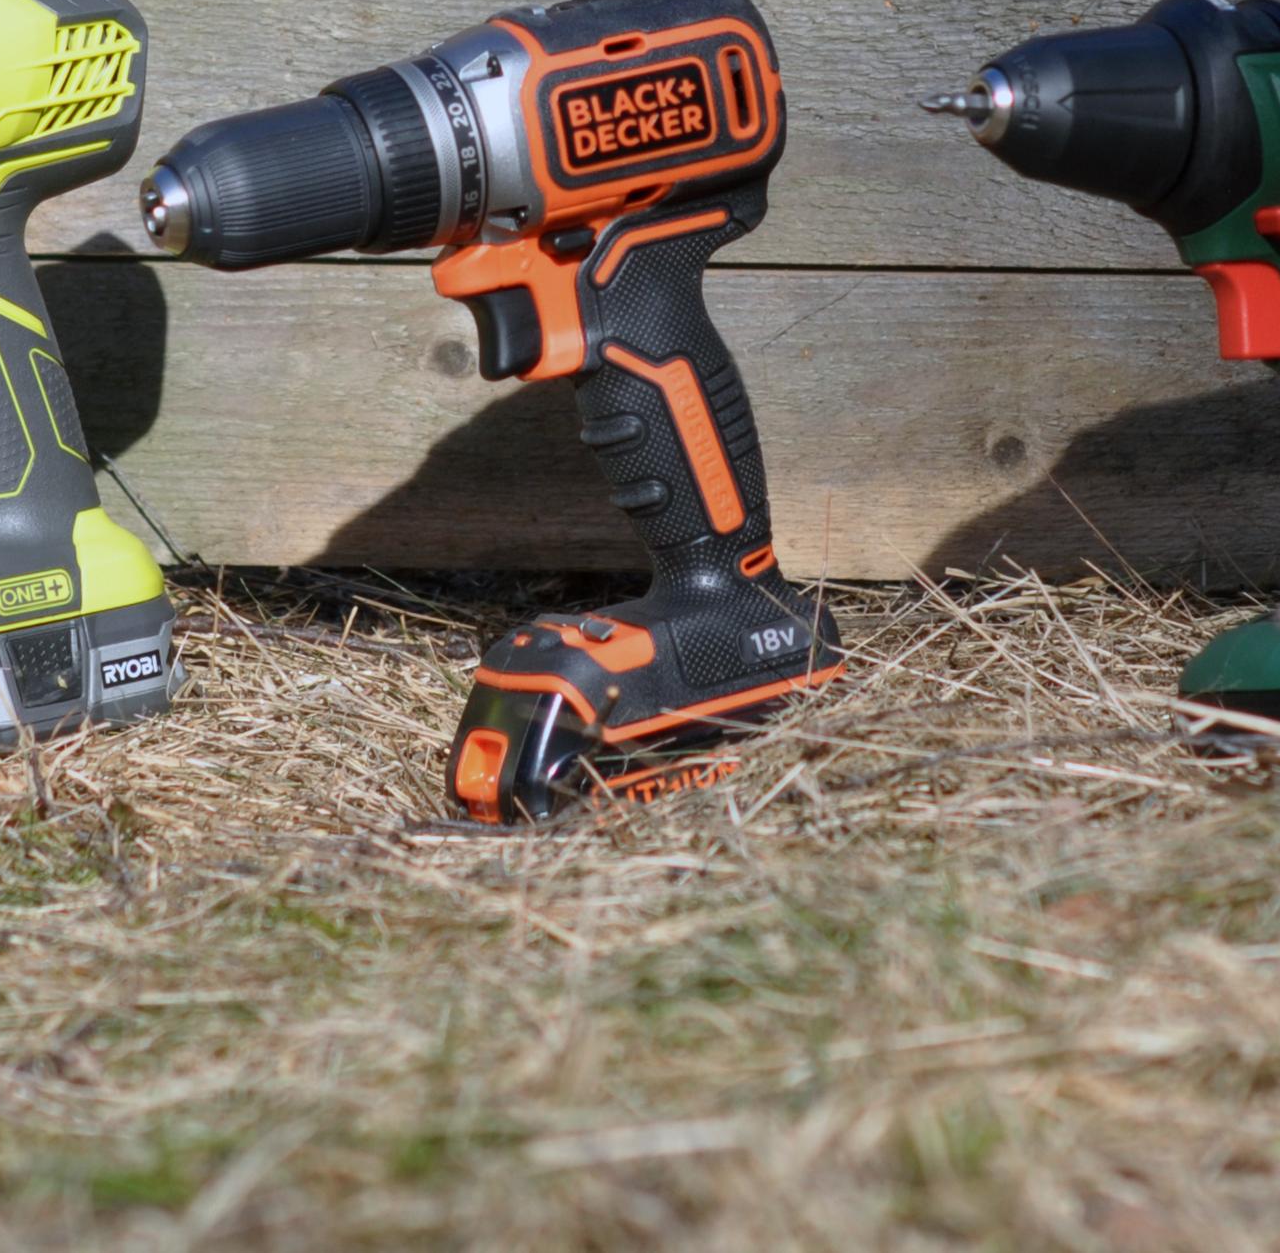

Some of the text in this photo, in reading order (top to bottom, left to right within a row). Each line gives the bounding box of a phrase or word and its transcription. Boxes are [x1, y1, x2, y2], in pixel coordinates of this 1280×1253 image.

[431, 71, 452, 90] 22
[448, 102, 470, 128] 20
[567, 77, 696, 127] BLACK+
[573, 105, 705, 158] DECKER
[461, 146, 477, 168] 18
[103, 654, 159, 685] RYOBI
